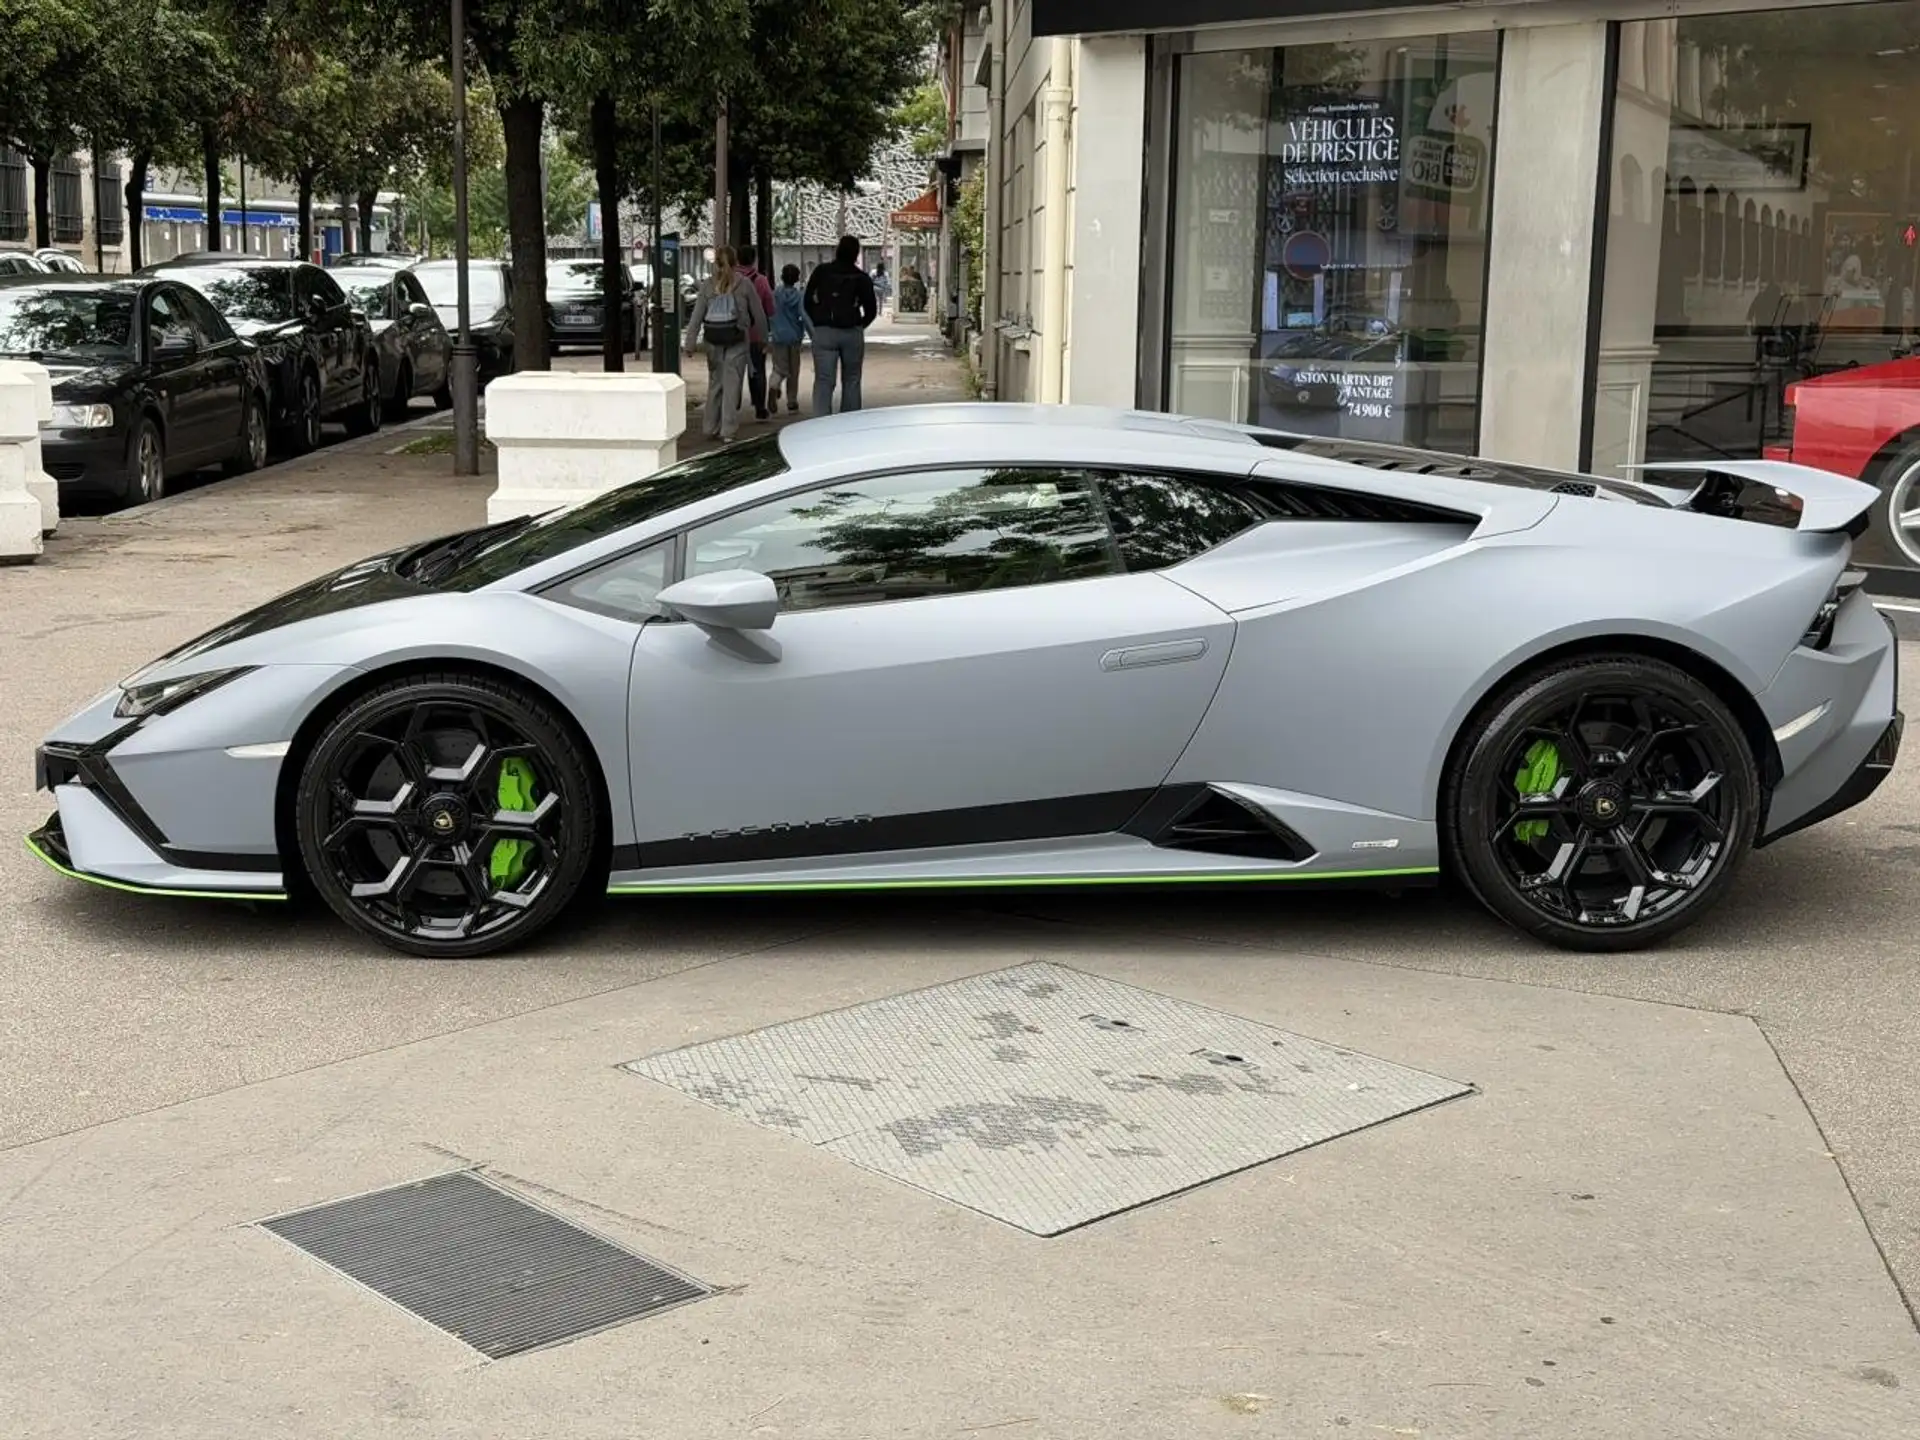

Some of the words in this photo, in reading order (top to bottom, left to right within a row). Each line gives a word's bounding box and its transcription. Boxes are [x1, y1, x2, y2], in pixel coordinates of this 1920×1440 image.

[1290, 116, 1394, 141] VÉHICULES
[1282, 143, 1308, 163] DE
[1311, 139, 1400, 163] PRESTIGE
[1284, 167, 1340, 184] Sélection
[1341, 165, 1399, 182] exclusive
[1294, 372, 1328, 384] ASTON
[1329, 372, 1371, 386] MARTIN
[1345, 386, 1393, 399] VANTAGE
